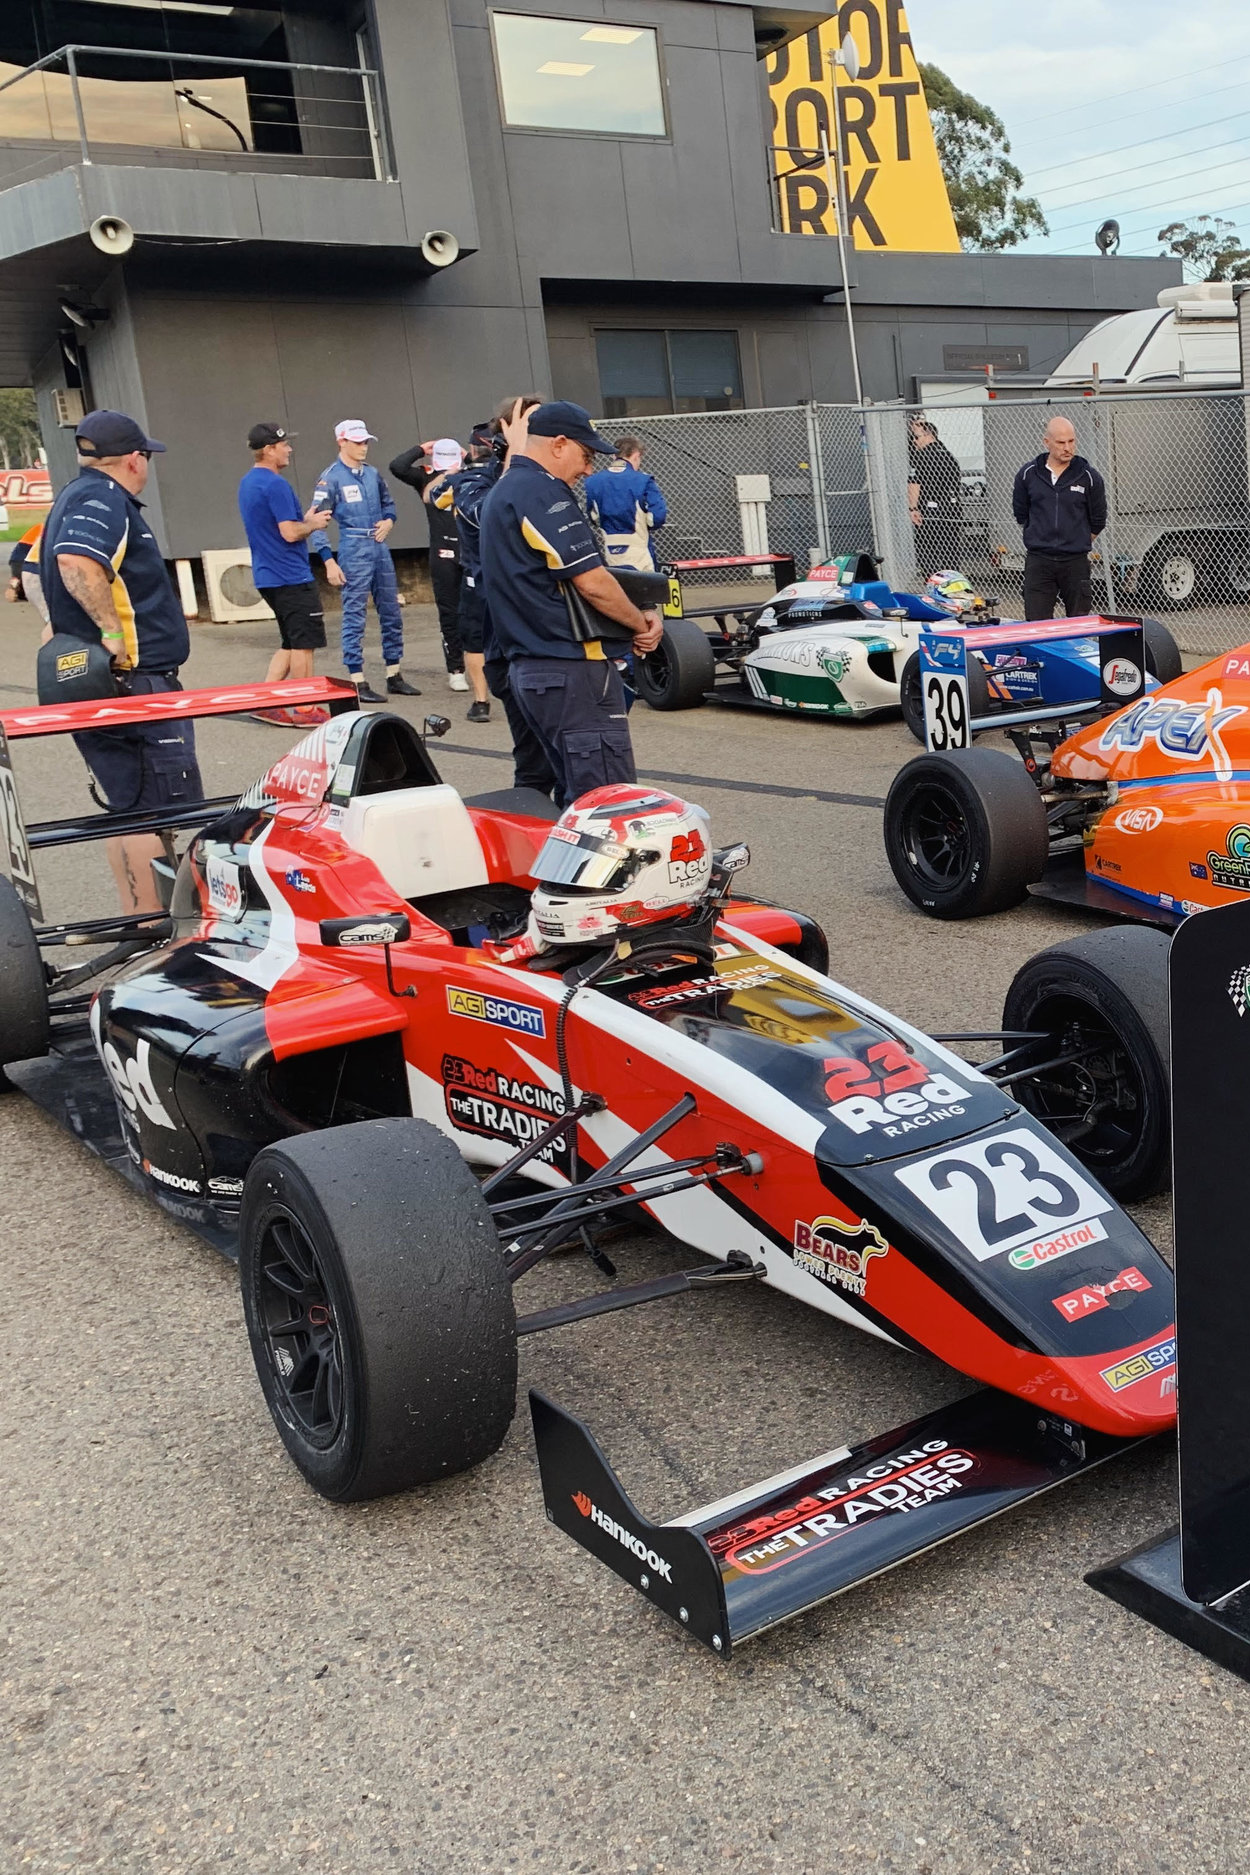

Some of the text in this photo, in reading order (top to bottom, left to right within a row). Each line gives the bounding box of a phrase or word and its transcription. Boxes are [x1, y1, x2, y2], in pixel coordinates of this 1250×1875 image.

[772, 82, 920, 170] ORT
[809, 569, 839, 579] PAYCE
[58, 653, 86, 671] AGI
[933, 643, 962, 660] F4
[13, 684, 330, 727] PAYCE
[927, 677, 967, 751] 39
[1100, 688, 1248, 780] APEX
[270, 762, 322, 798] PAYCE
[669, 828, 706, 862] 23
[667, 859, 709, 885] Red
[668, 971, 783, 1001] TRADIES
[692, 964, 770, 986] RACING
[452, 990, 543, 1033] AGI SPORT
[824, 1041, 930, 1103] 23
[450, 1097, 473, 1115] THE
[498, 1076, 566, 1115] RACING
[827, 1072, 973, 1135] Red
[882, 1104, 967, 1138] RACING
[519, 1139, 554, 1162] TAM
[928, 1141, 1081, 1247] 23
[794, 1219, 862, 1275] BEARS
[1032, 1224, 1097, 1263] Castrol
[793, 1248, 867, 1287] LOWER PLENTY
[1062, 1272, 1143, 1316] PAYCE
[1114, 1358, 1150, 1386] AGI
[817, 1439, 949, 1502] RACING
[738, 1453, 974, 1565] THE TRADIES
[890, 1478, 963, 1514] TEAM
